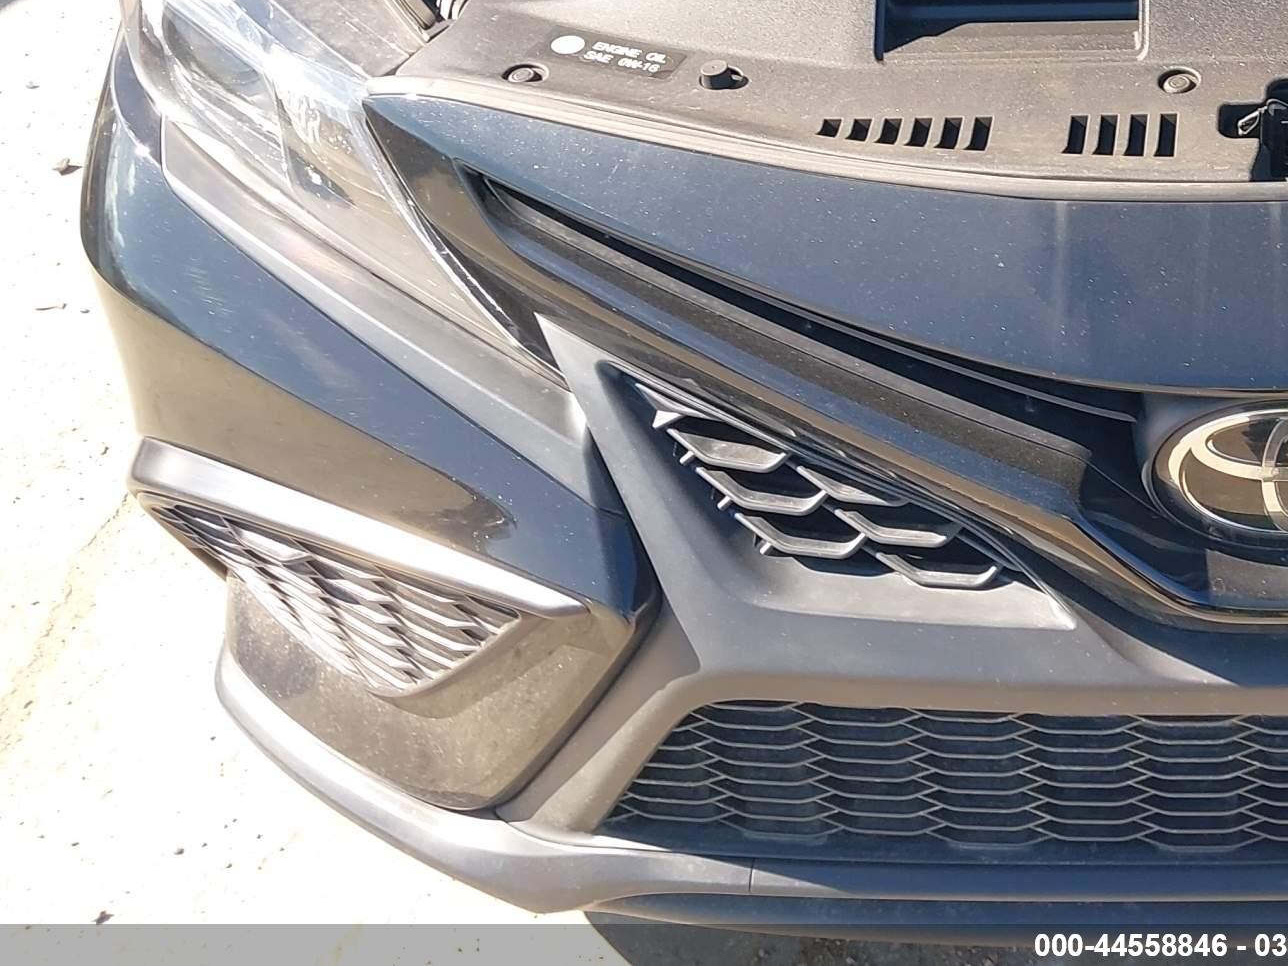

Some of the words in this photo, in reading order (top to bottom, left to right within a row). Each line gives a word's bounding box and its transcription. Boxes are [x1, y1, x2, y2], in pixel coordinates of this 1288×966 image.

[583, 50, 613, 63] SAE
[617, 58, 660, 73] 0W-16
[592, 41, 642, 58] ENGINE
[645, 52, 666, 64] OIL
